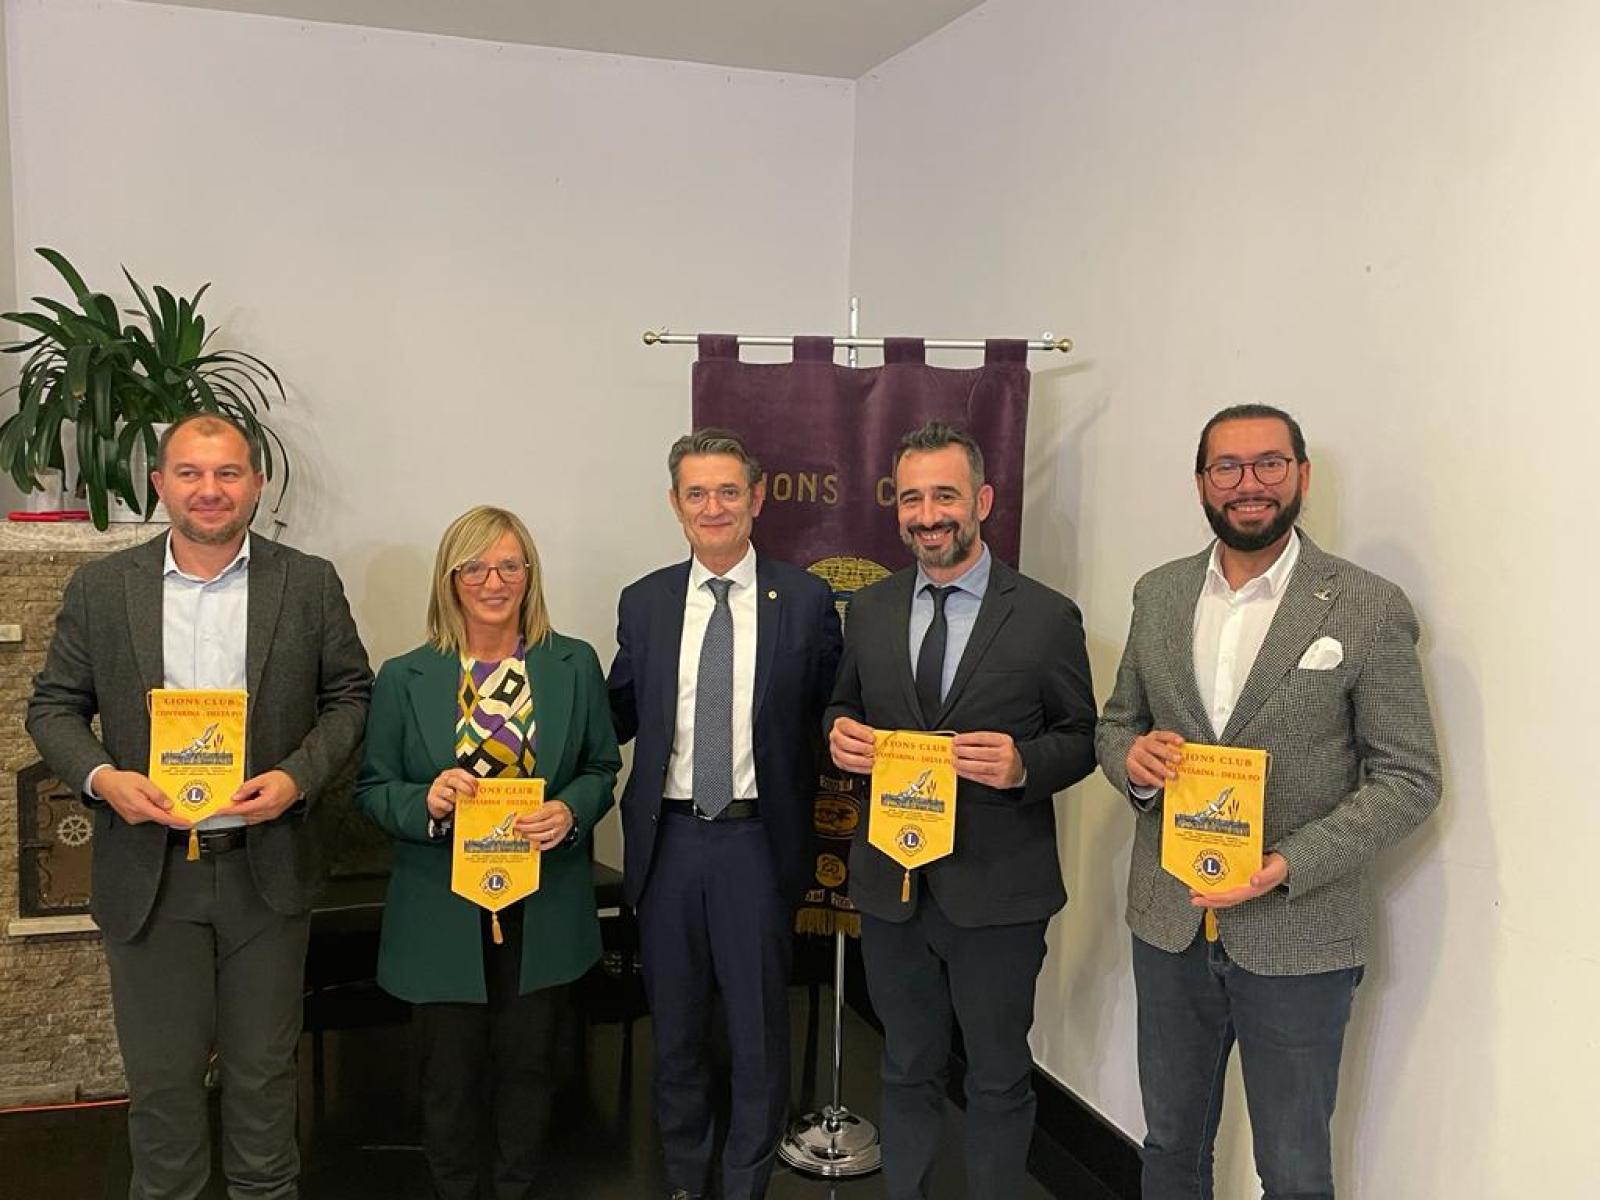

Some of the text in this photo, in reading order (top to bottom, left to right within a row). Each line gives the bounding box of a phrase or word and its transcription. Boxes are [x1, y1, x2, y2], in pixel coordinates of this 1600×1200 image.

[762, 471, 839, 505] ONS
[164, 697, 235, 706] LIONS CLUB
[920, 743, 947, 752] CLUB
[1220, 756, 1252, 767] CLUB
[1221, 770, 1247, 781] DELTA
[1247, 774, 1260, 782] PO
[191, 788, 201, 801] L
[506, 786, 533, 795] CLUB
[907, 833, 917, 846] L
[1207, 859, 1217, 873] L
[492, 876, 501, 888] L
